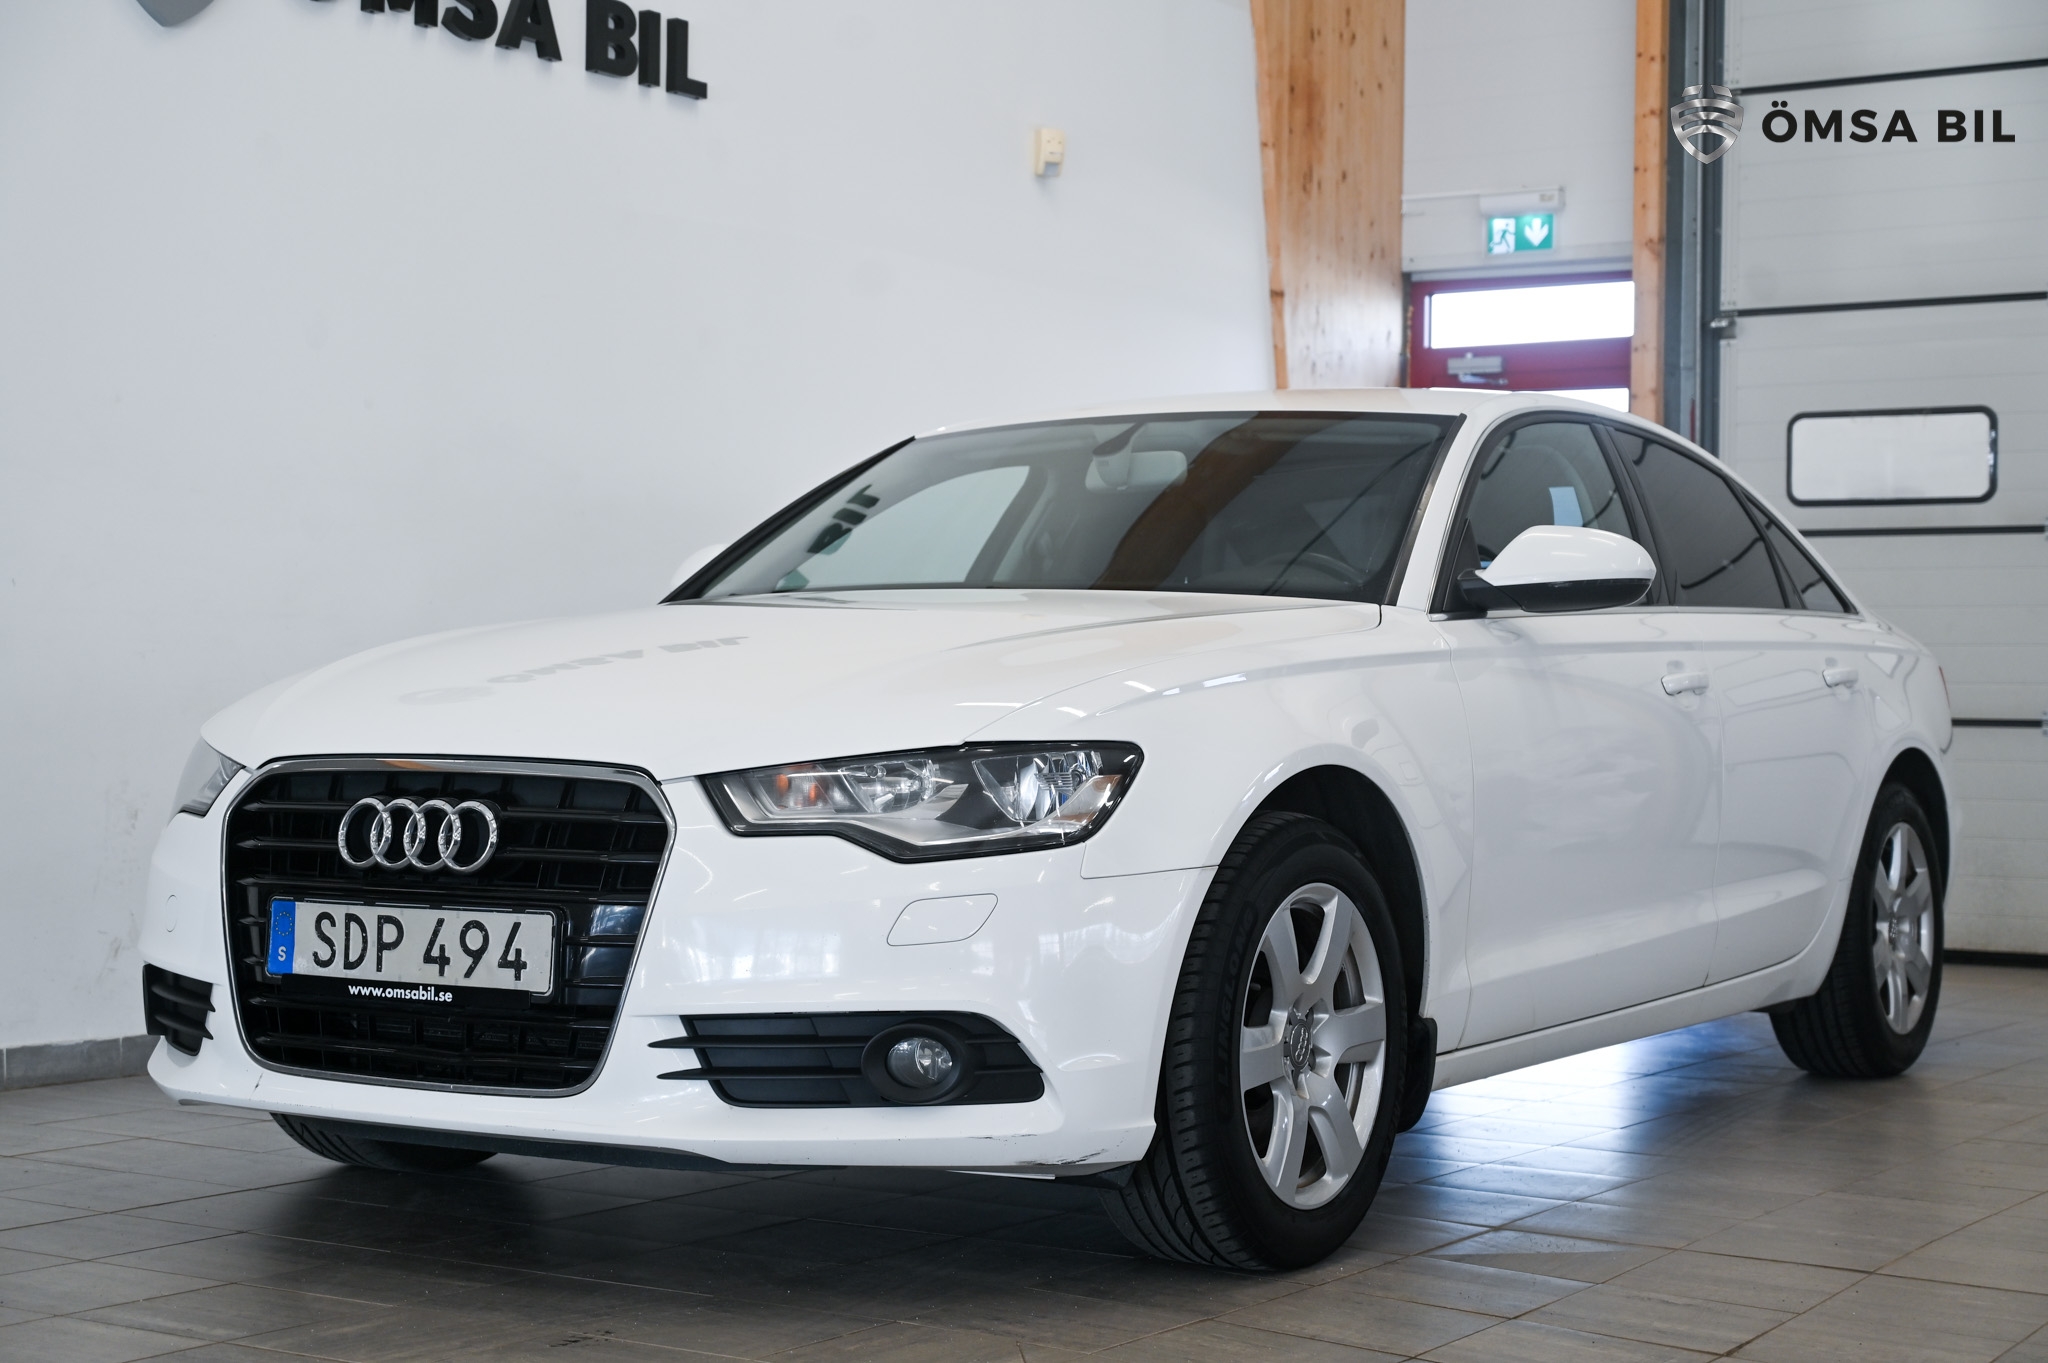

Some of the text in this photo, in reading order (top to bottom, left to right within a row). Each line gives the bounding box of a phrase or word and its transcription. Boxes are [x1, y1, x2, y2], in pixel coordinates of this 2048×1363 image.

[586, 0, 707, 100] BIL
[277, 946, 287, 962] S
[312, 911, 527, 981] SDP 494
[348, 984, 453, 1003] www.omsabil.se
